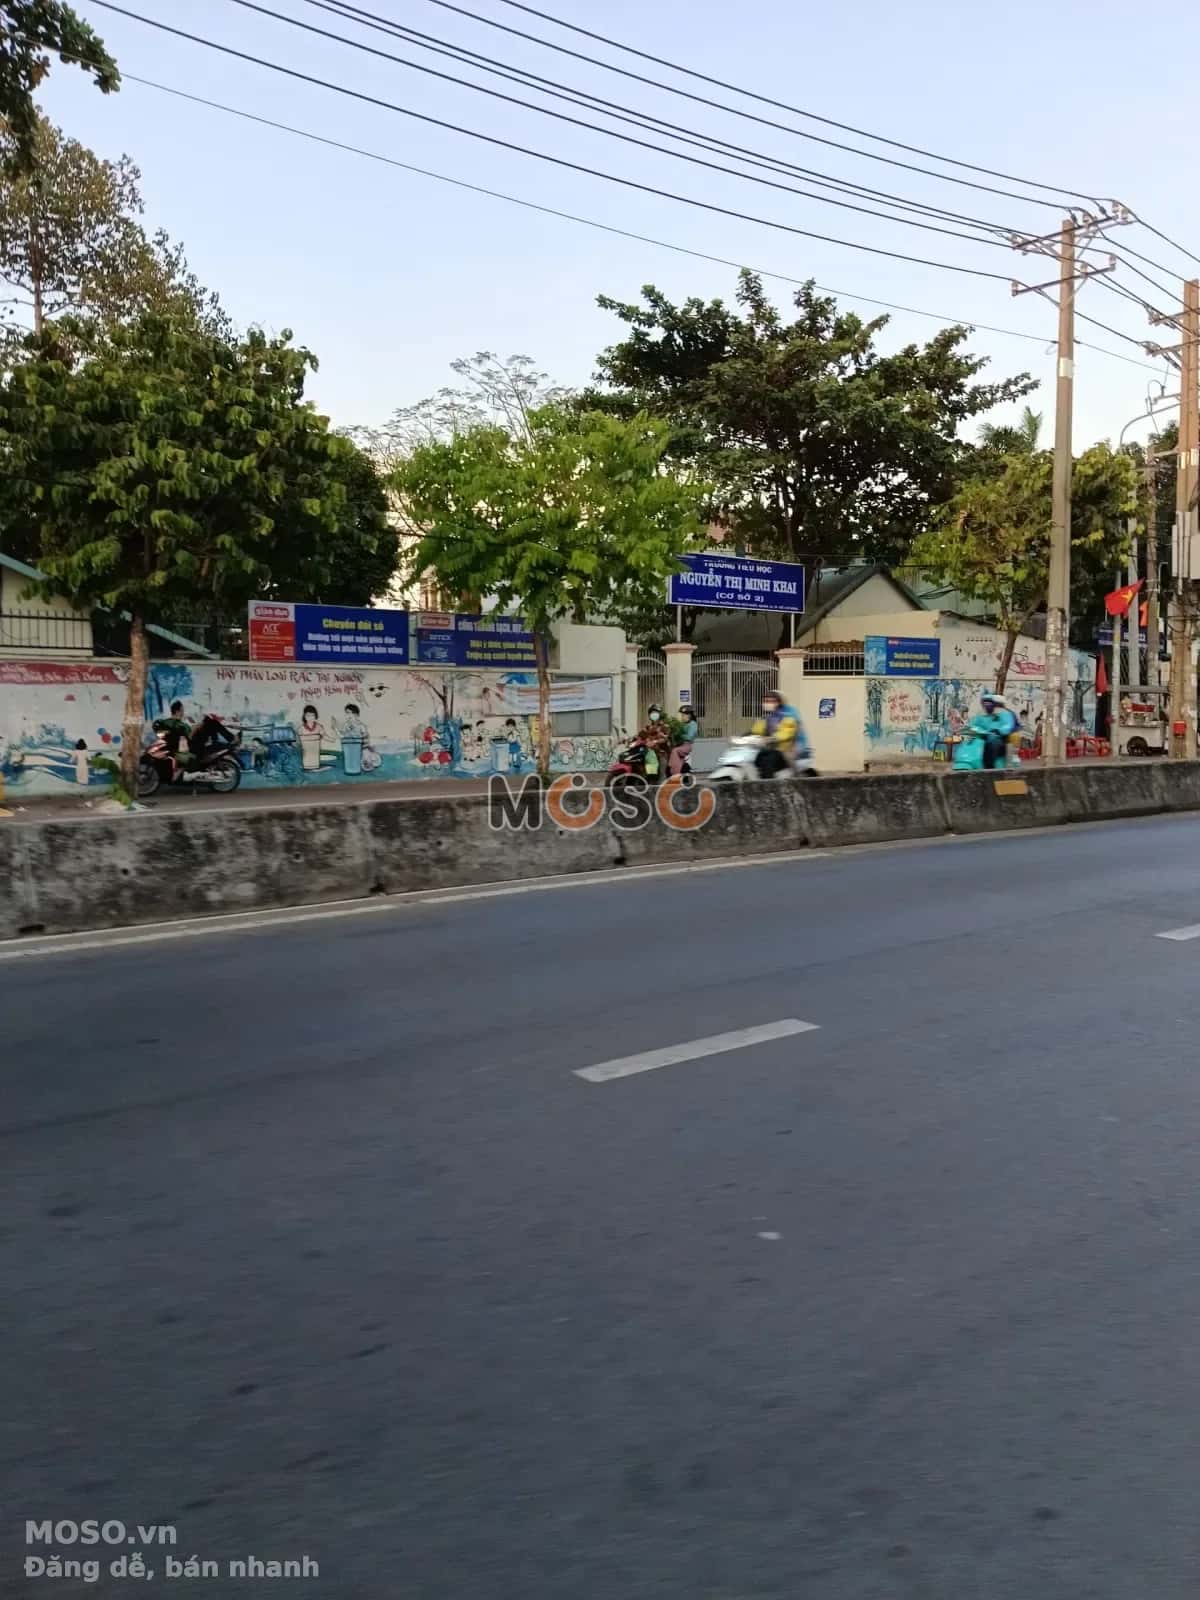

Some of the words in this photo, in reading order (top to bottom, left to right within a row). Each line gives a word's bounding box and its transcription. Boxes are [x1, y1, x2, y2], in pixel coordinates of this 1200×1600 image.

[757, 566, 772, 574] HỌC
[679, 568, 722, 588] NGUYỄN
[724, 576, 742, 592] THỊ
[745, 577, 770, 592] MINH
[772, 580, 797, 594] KHAI
[715, 591, 734, 601] (CƠ
[754, 595, 764, 603] 2)
